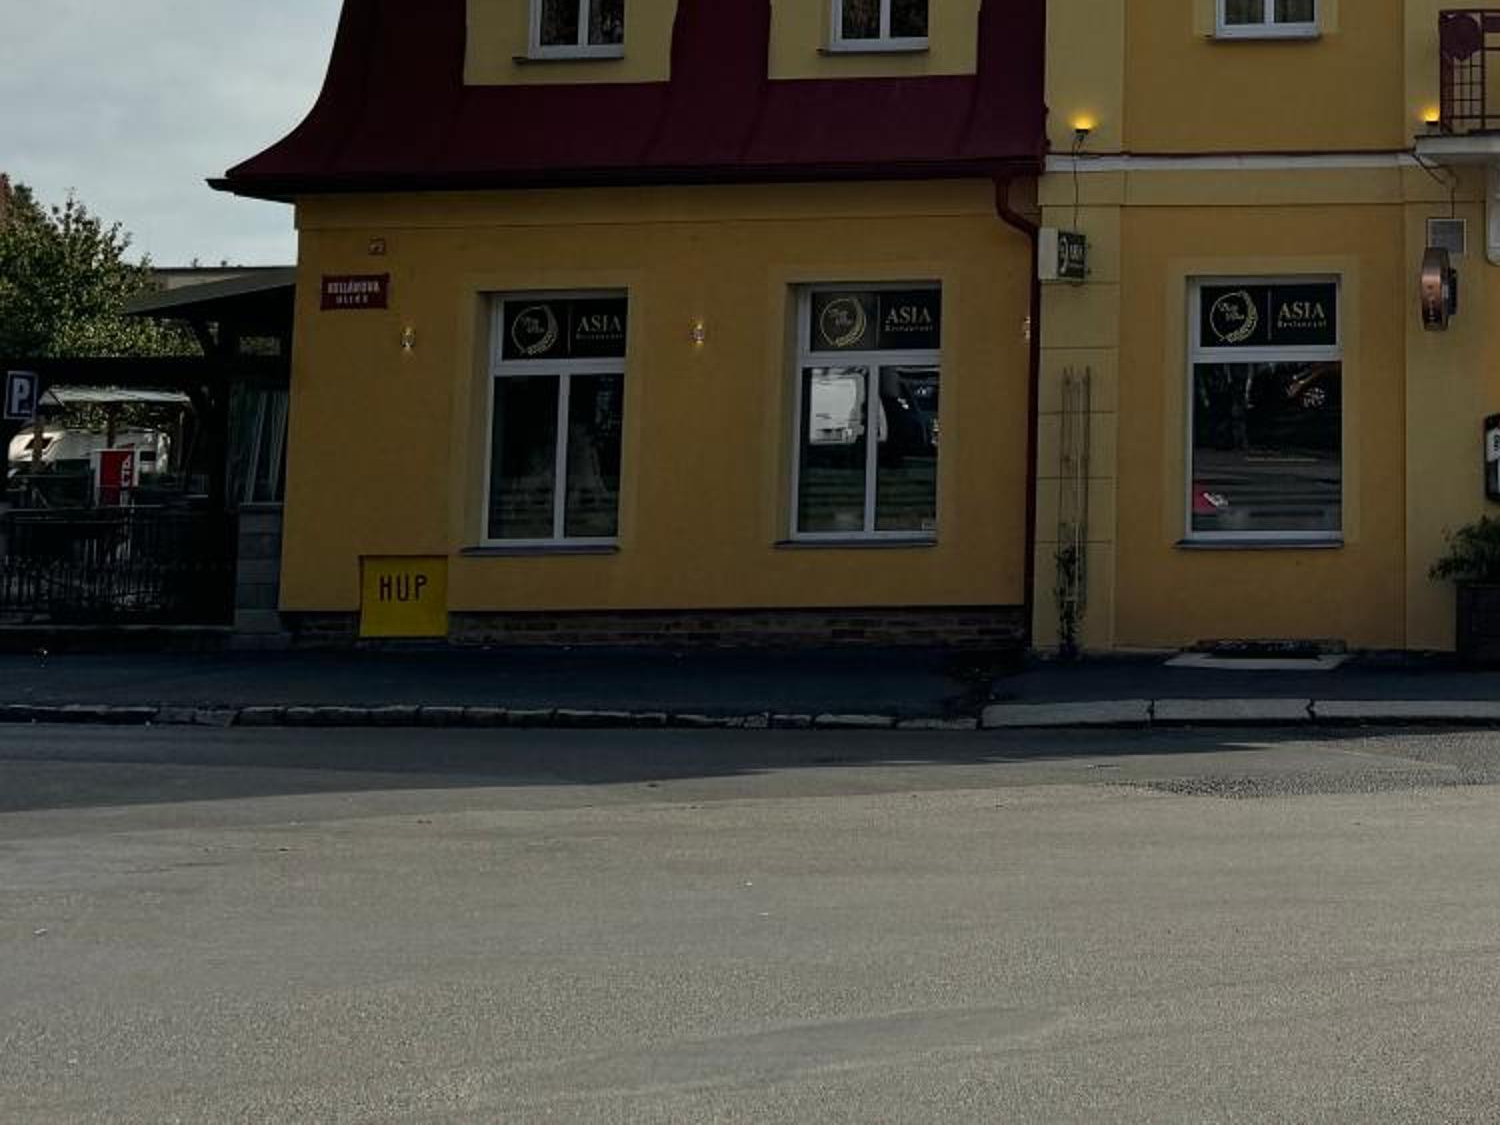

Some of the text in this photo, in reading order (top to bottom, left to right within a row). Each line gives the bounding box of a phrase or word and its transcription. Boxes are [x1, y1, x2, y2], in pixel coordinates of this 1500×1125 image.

[885, 306, 932, 324] ASIA
[1279, 301, 1325, 319] ASIA
[577, 314, 624, 332] ASIA
[11, 377, 31, 415] P
[380, 574, 428, 602] HUP
